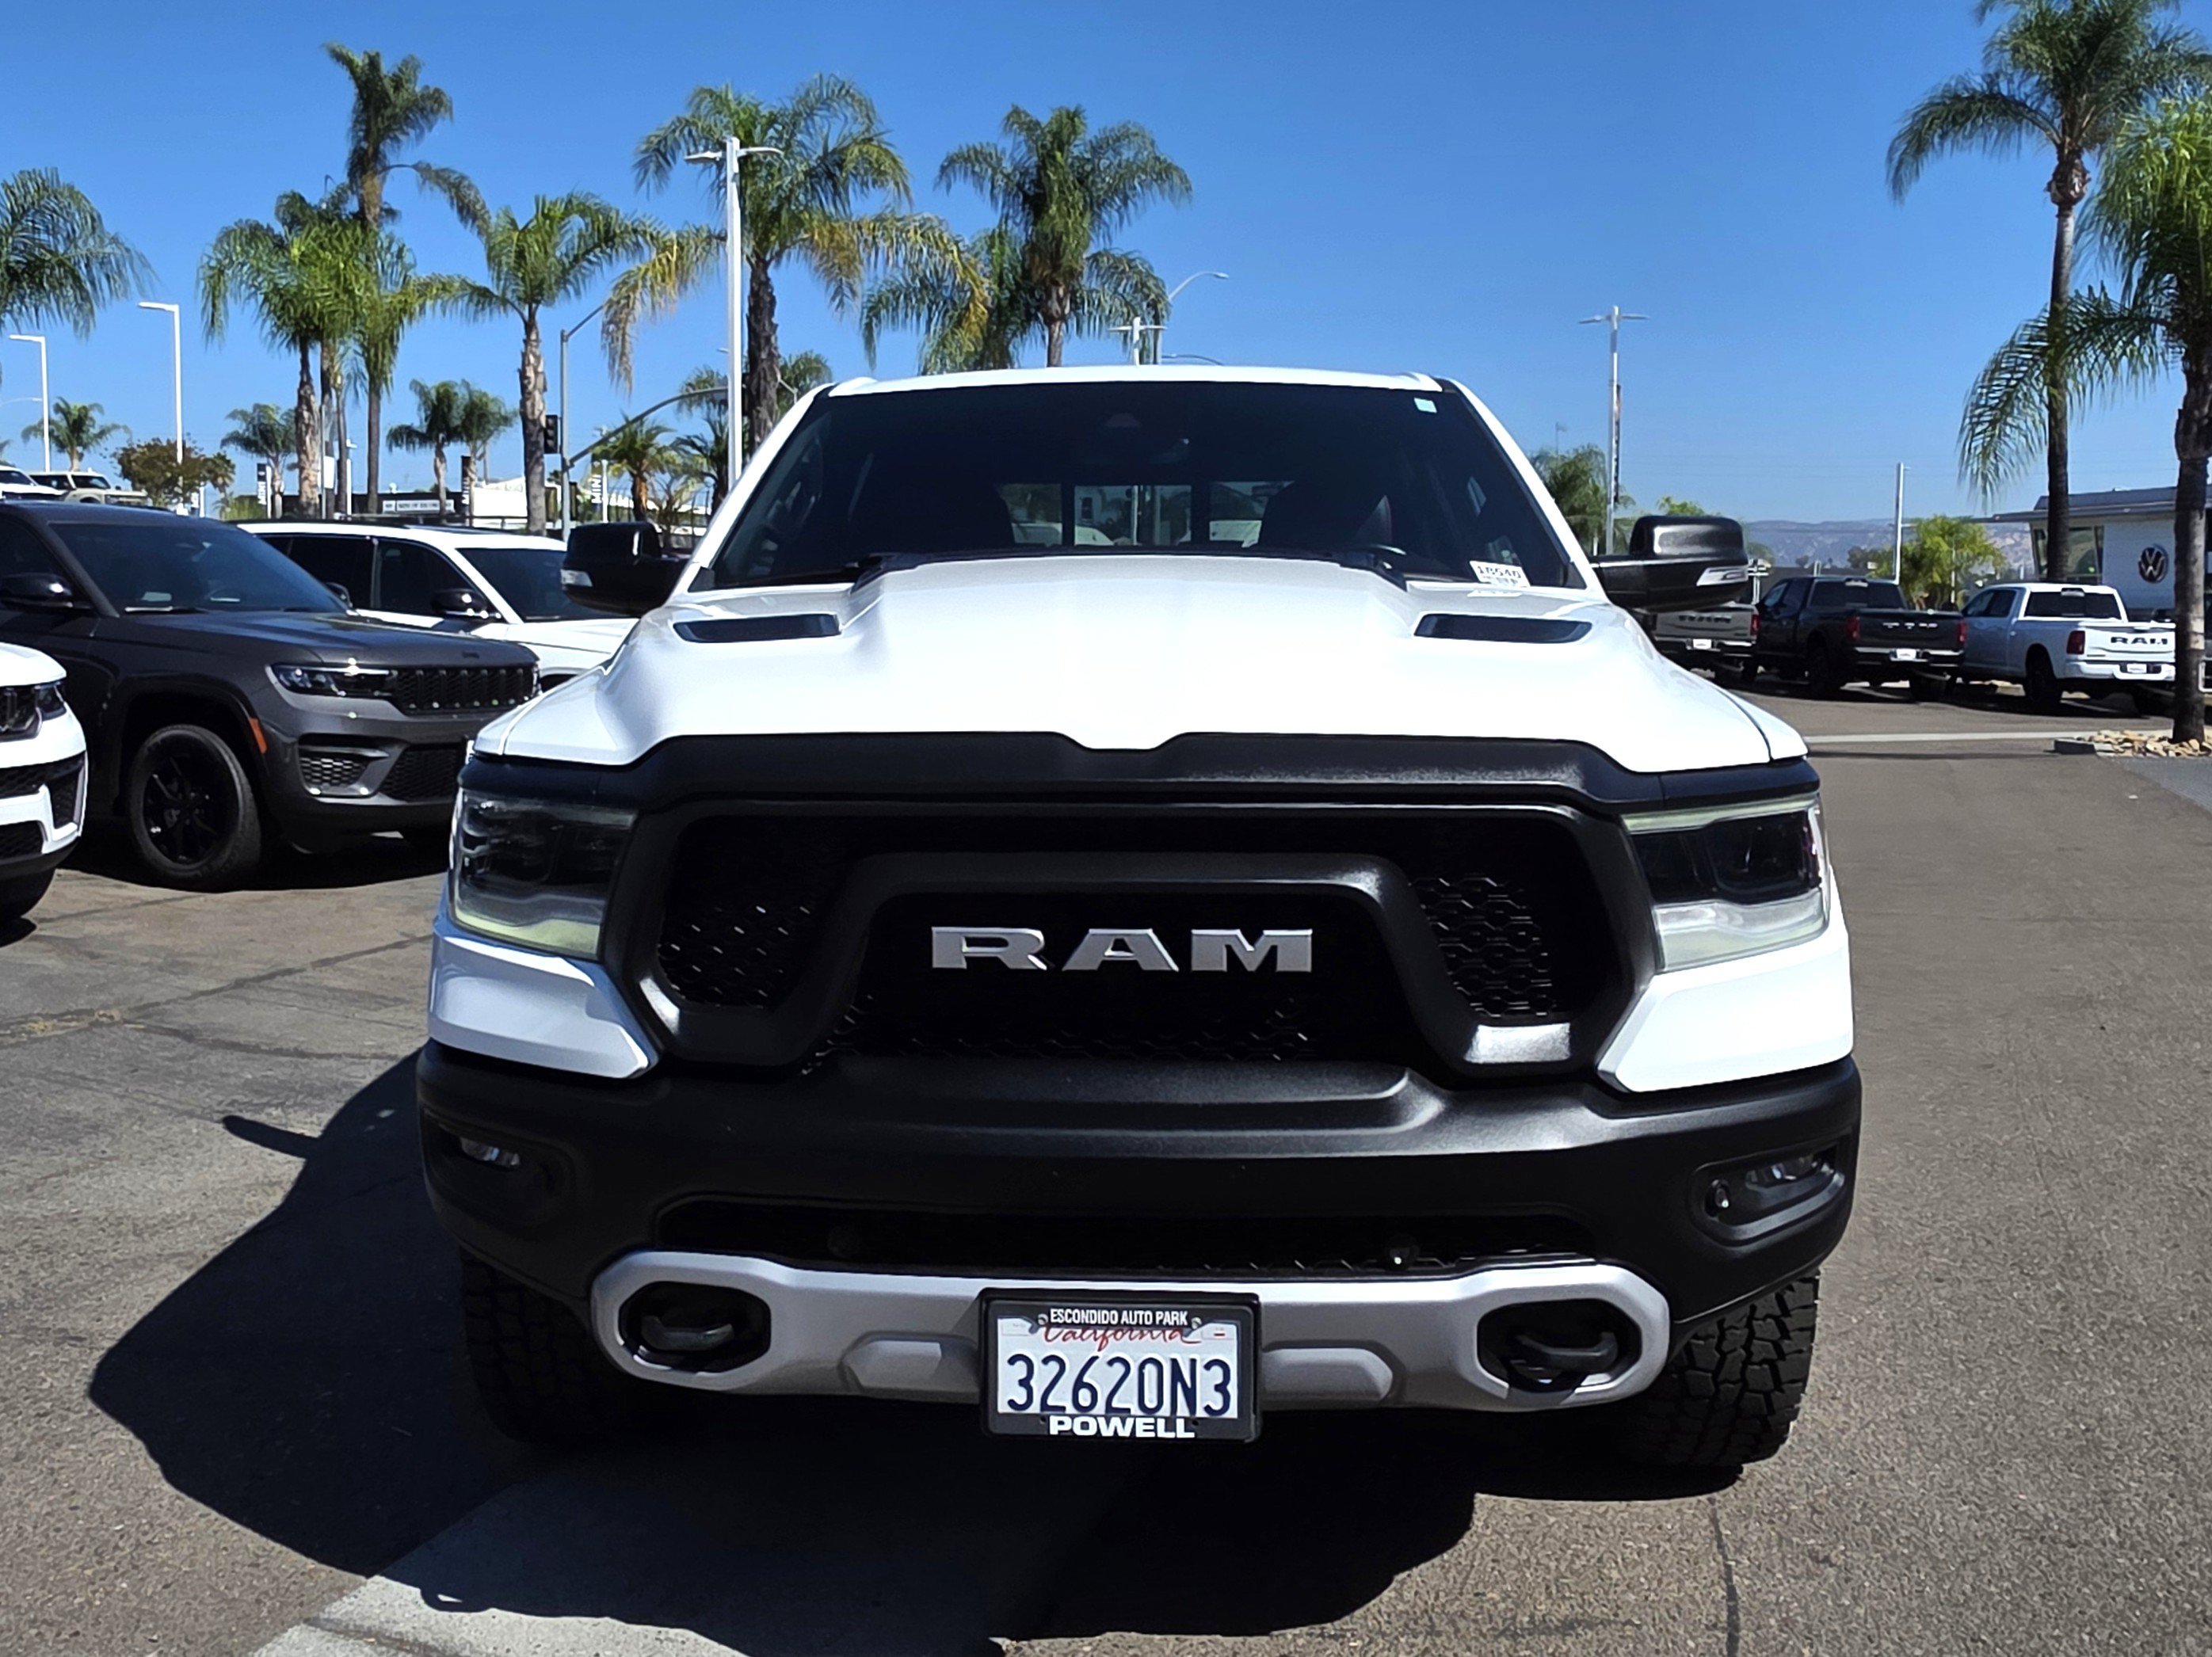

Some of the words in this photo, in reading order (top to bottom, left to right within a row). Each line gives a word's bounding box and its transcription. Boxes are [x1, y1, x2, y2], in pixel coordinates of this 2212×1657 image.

[2111, 636, 2168, 645] RAM
[932, 927, 1312, 972] RAM
[1050, 1308, 1119, 1325] ESCONDIDO
[1120, 1310, 1154, 1325] AUTO
[1155, 1311, 1188, 1326] PARK
[1007, 1353, 1231, 1416] 32620N3
[1049, 1415, 1196, 1438] POWELL
